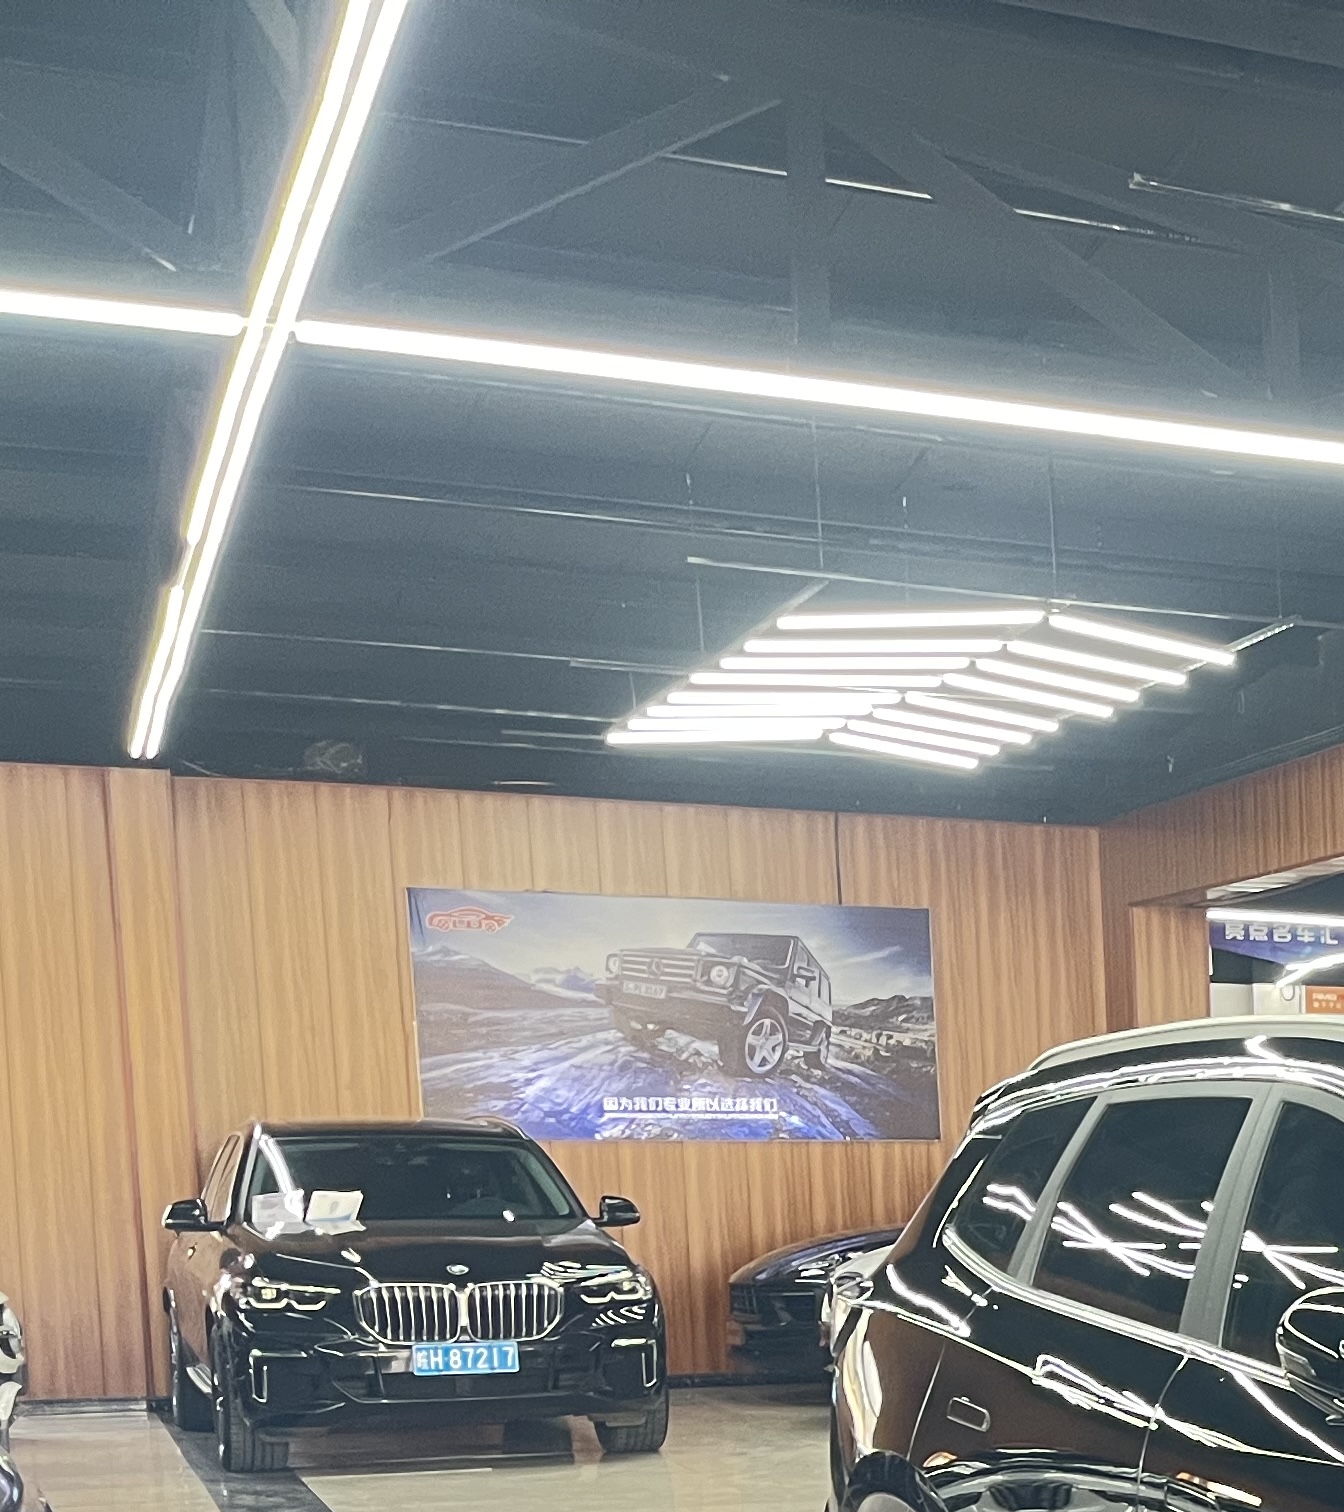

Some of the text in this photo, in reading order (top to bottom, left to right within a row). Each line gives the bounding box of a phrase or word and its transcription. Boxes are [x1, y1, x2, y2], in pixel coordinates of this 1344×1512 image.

[1224, 922, 1339, 945] 亮点名车汇
[602, 1095, 779, 1113] 因为我们专业所以选择我们
